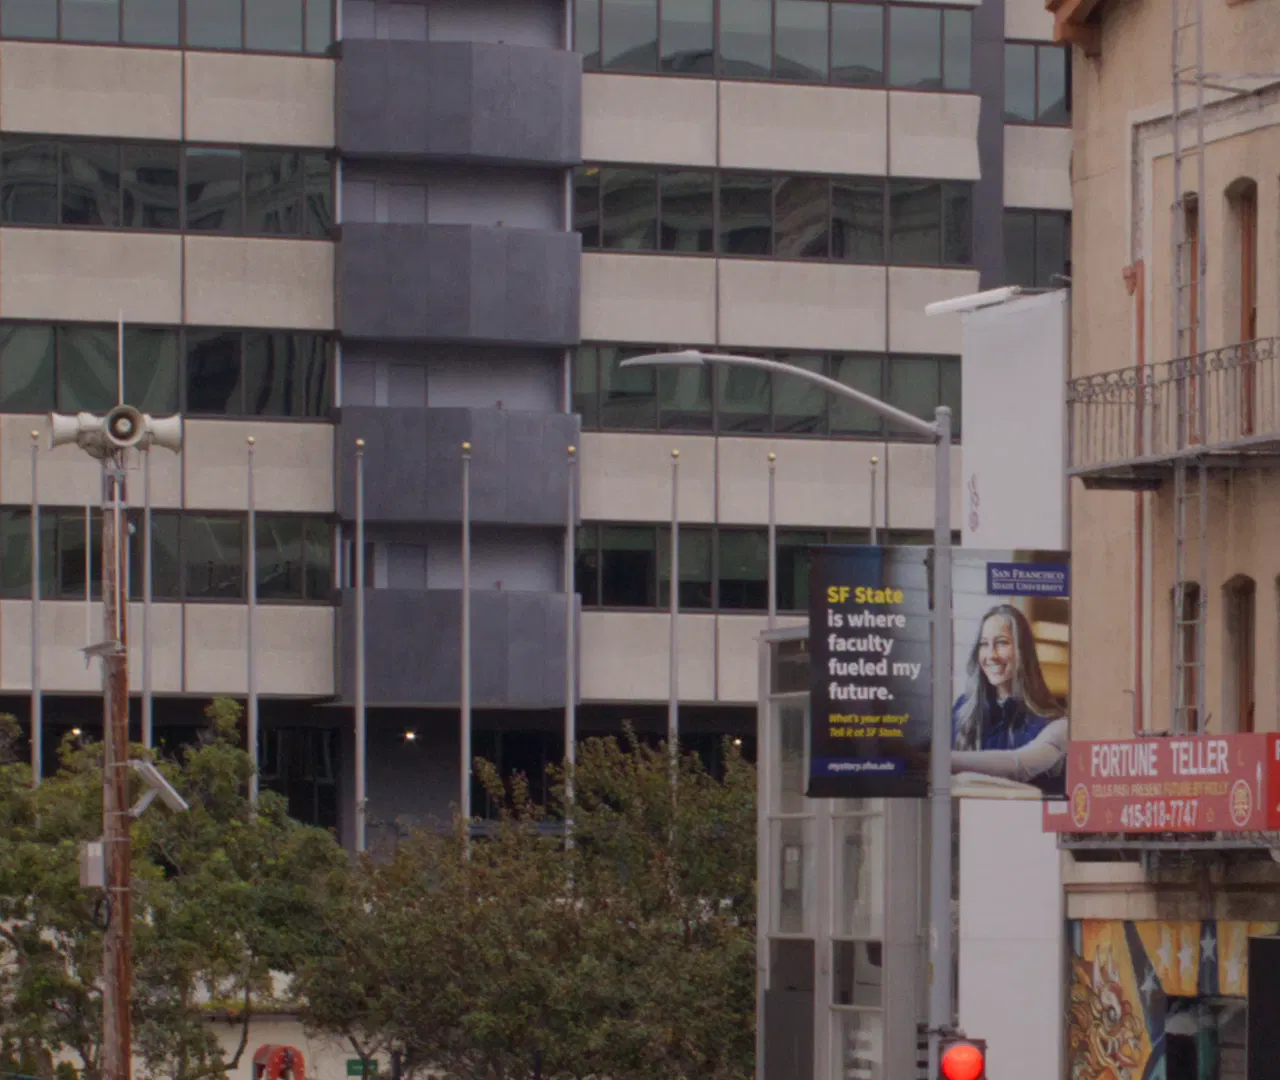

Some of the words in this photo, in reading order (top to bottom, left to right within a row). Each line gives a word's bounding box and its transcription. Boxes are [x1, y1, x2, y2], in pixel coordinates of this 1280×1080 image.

[991, 568, 1010, 578] SAN
[1012, 568, 1065, 580] FRANCISCO
[827, 586, 851, 604] SF
[854, 586, 904, 604] State
[1016, 582, 1064, 592] UNIVERSITY
[827, 609, 844, 628] is
[847, 610, 906, 628] where
[827, 634, 894, 656] faculty
[828, 658, 888, 676] fueled
[892, 662, 921, 680] my
[828, 682, 894, 700] future.
[861, 715, 882, 726] your
[1090, 743, 1159, 777] FORTUNE
[1170, 739, 1229, 775] TELLER
